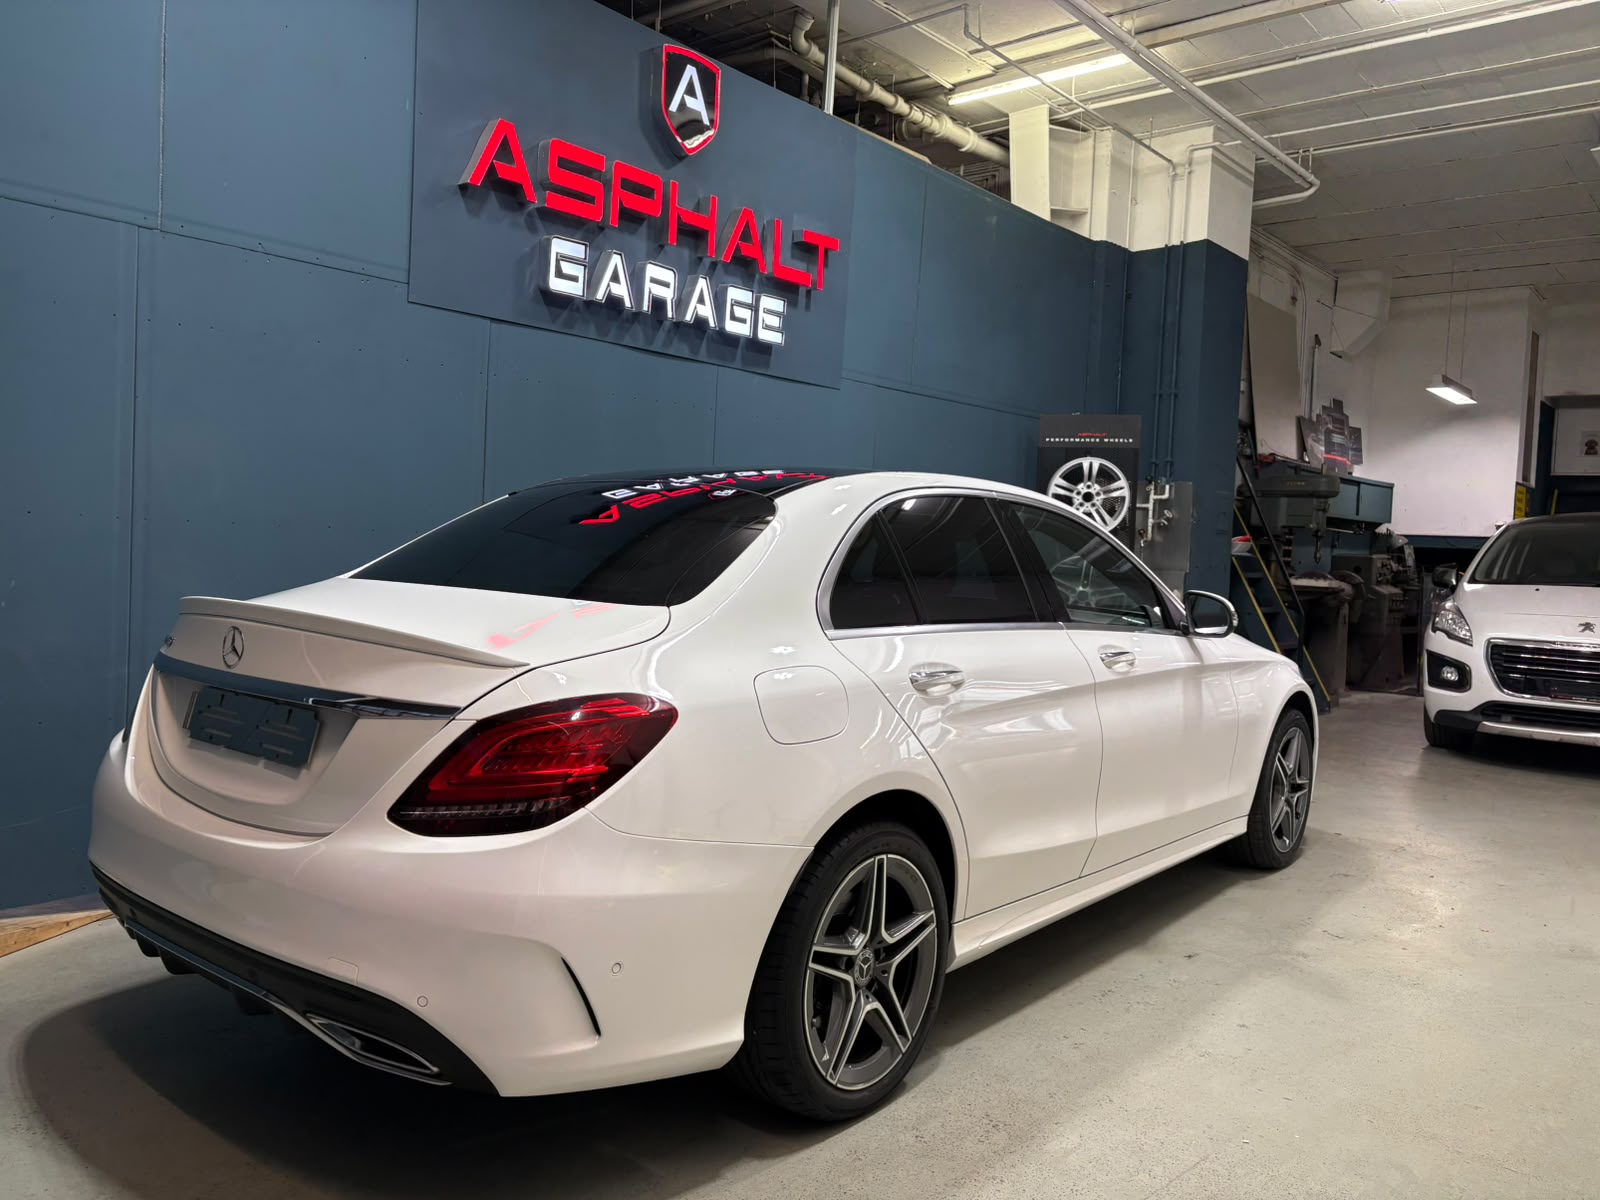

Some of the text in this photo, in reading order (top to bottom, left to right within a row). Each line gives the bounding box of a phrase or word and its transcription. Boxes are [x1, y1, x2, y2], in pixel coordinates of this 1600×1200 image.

[669, 64, 710, 126] A
[459, 118, 840, 291] ASPHALT
[549, 236, 787, 346] GARAGE
